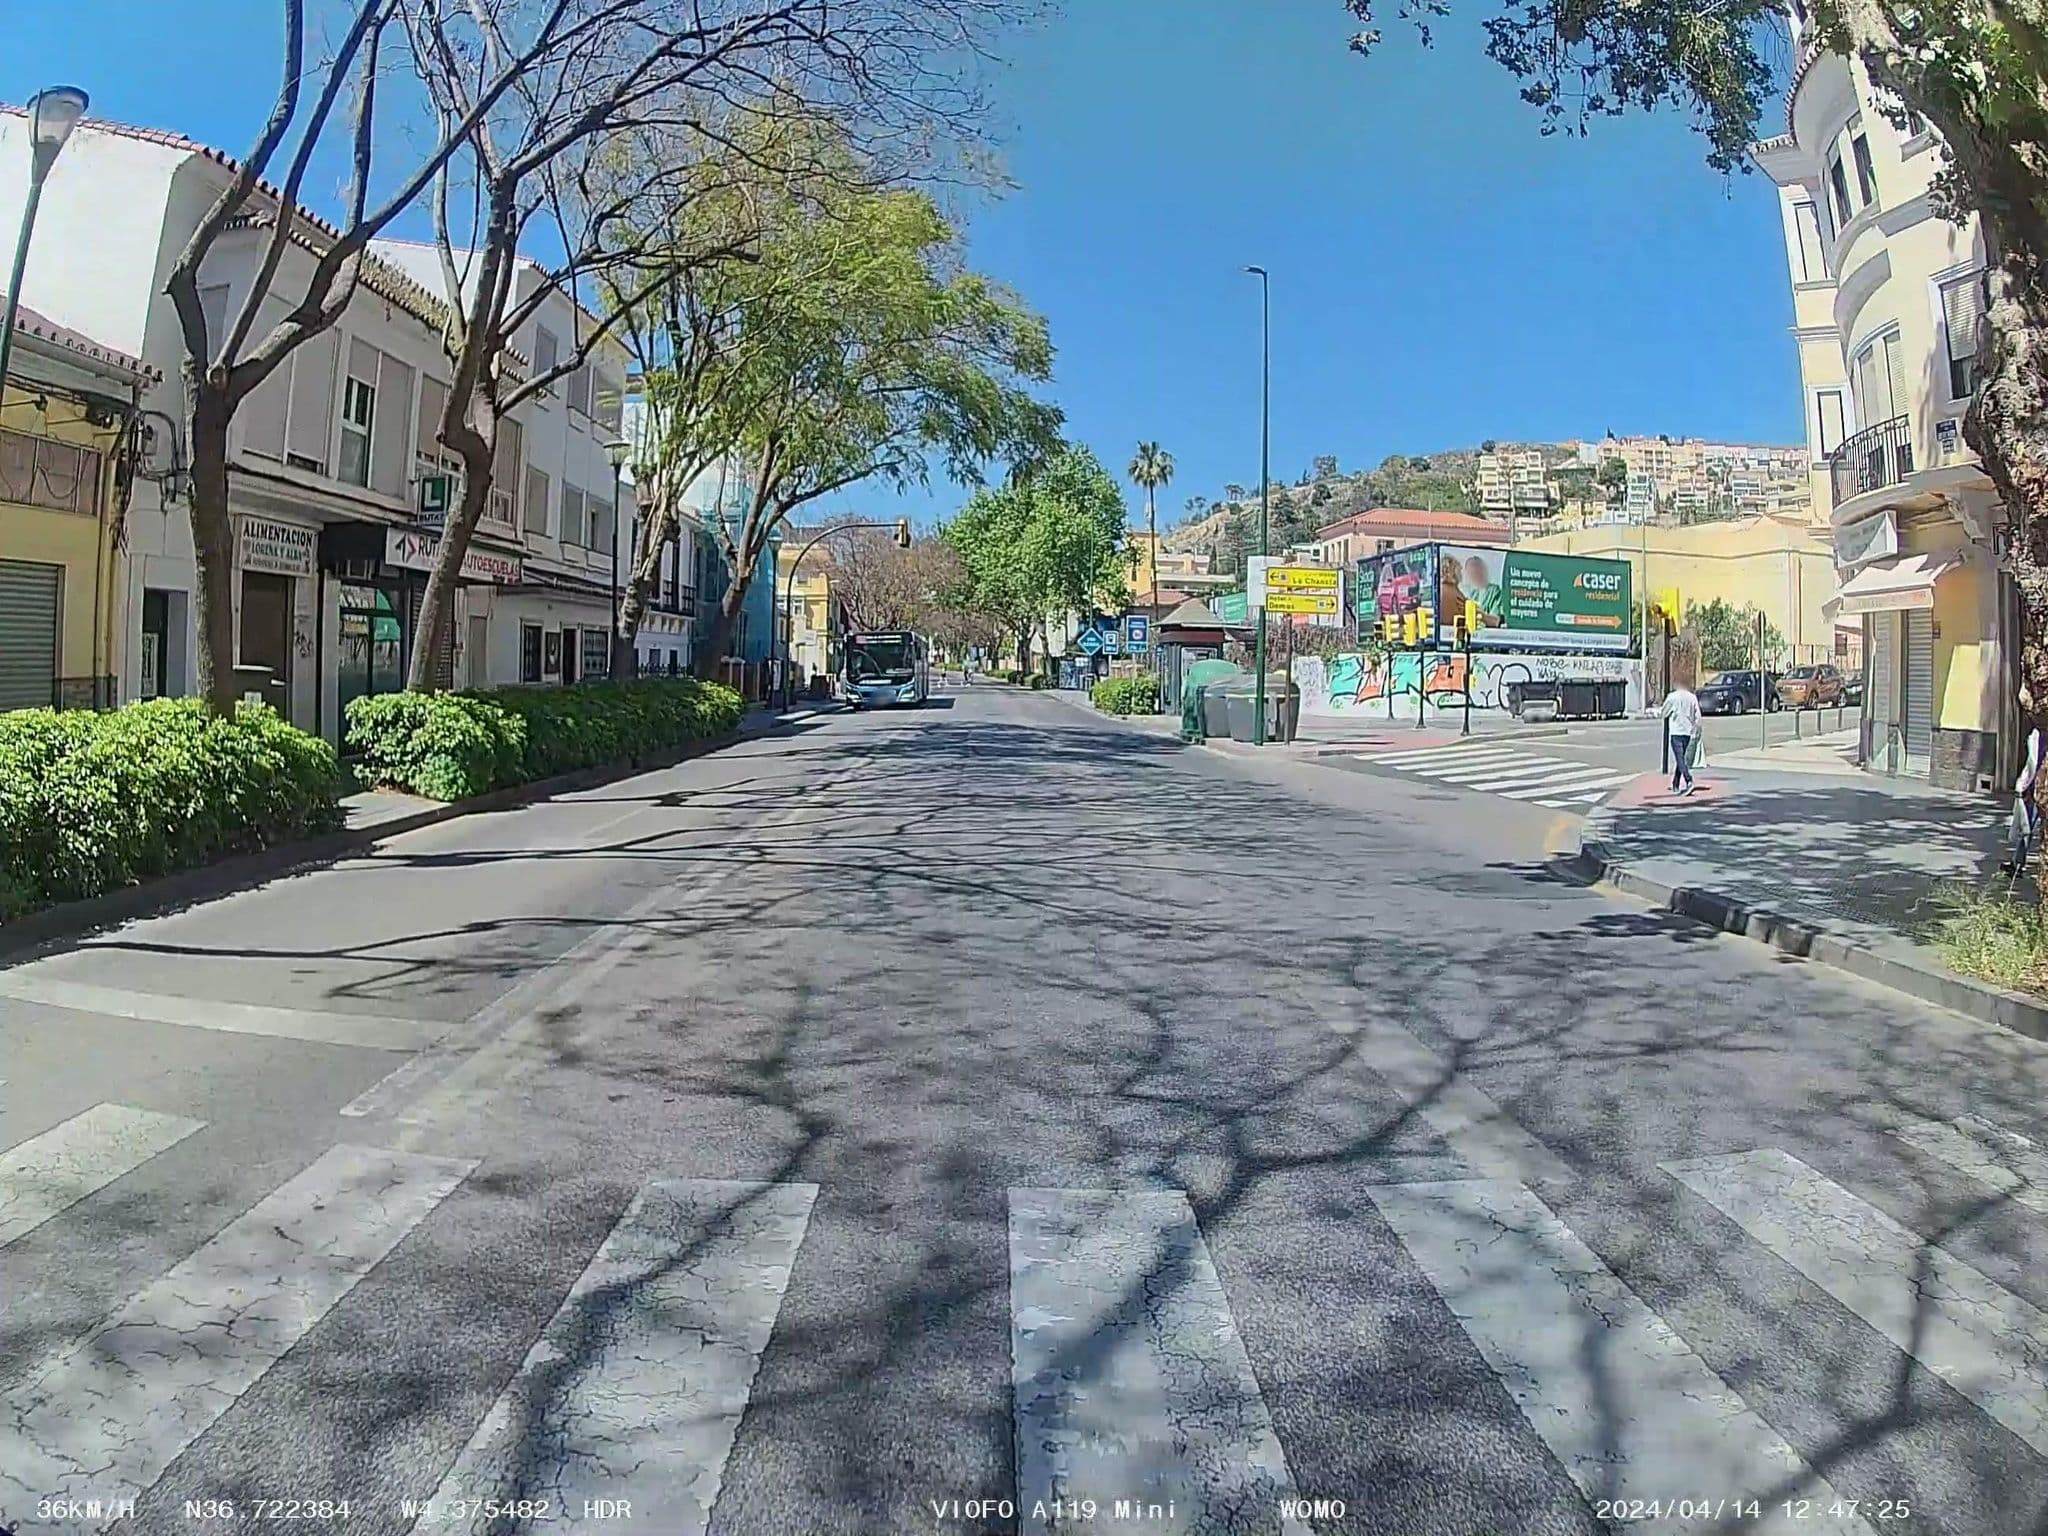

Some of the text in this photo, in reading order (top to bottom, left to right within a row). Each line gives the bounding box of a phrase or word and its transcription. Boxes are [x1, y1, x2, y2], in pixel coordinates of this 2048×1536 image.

[425, 482, 441, 507] L
[243, 520, 313, 547] ALIMENTACION
[1522, 569, 1541, 578] nuevo
[1510, 579, 1549, 589] concepto de
[1583, 573, 1621, 590] caser
[1543, 592, 1558, 601] para
[1518, 598, 1543, 608] cuidado
[1545, 600, 1554, 609] de
